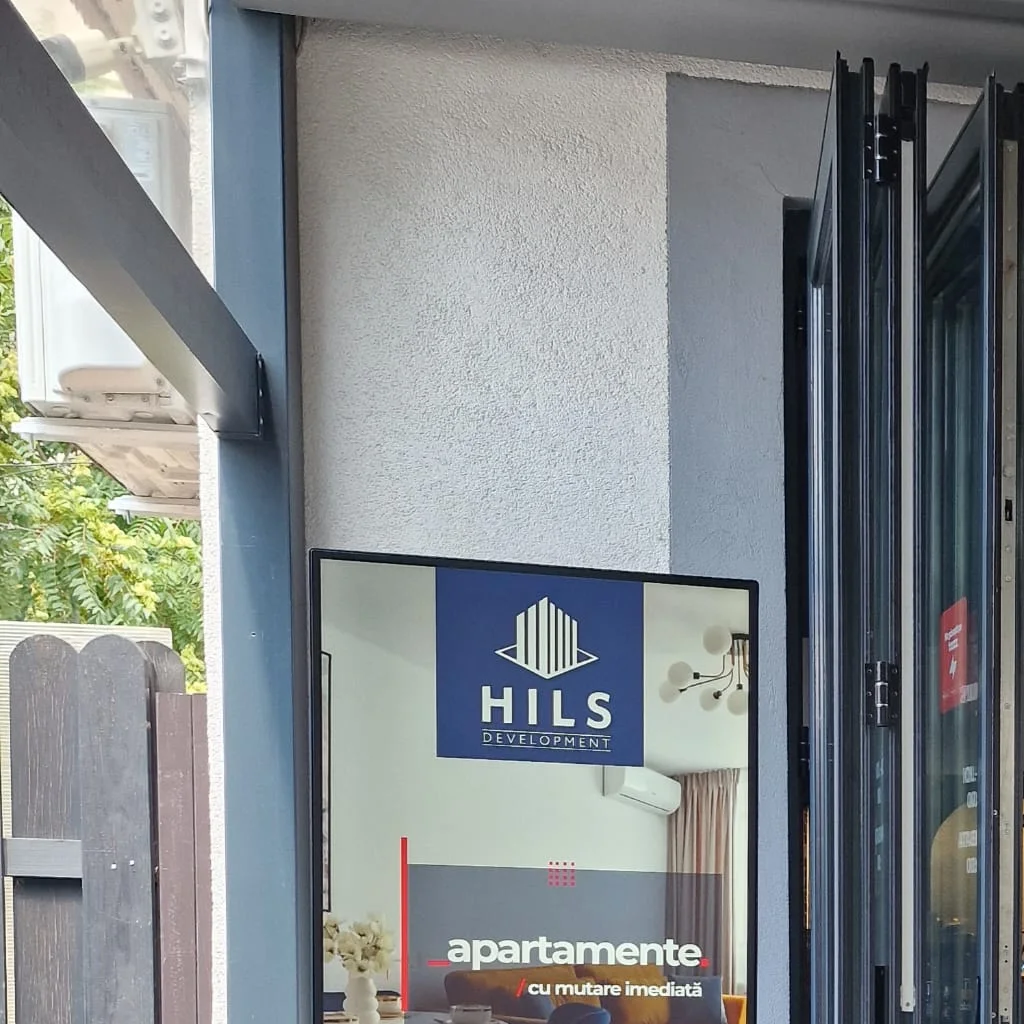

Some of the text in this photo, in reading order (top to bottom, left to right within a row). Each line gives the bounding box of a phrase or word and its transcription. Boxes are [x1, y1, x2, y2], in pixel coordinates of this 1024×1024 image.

[481, 685, 612, 730] HILS
[482, 732, 612, 749] DEVELOPMENT
[554, 981, 622, 997] mutare
[624, 981, 703, 998] imediată
